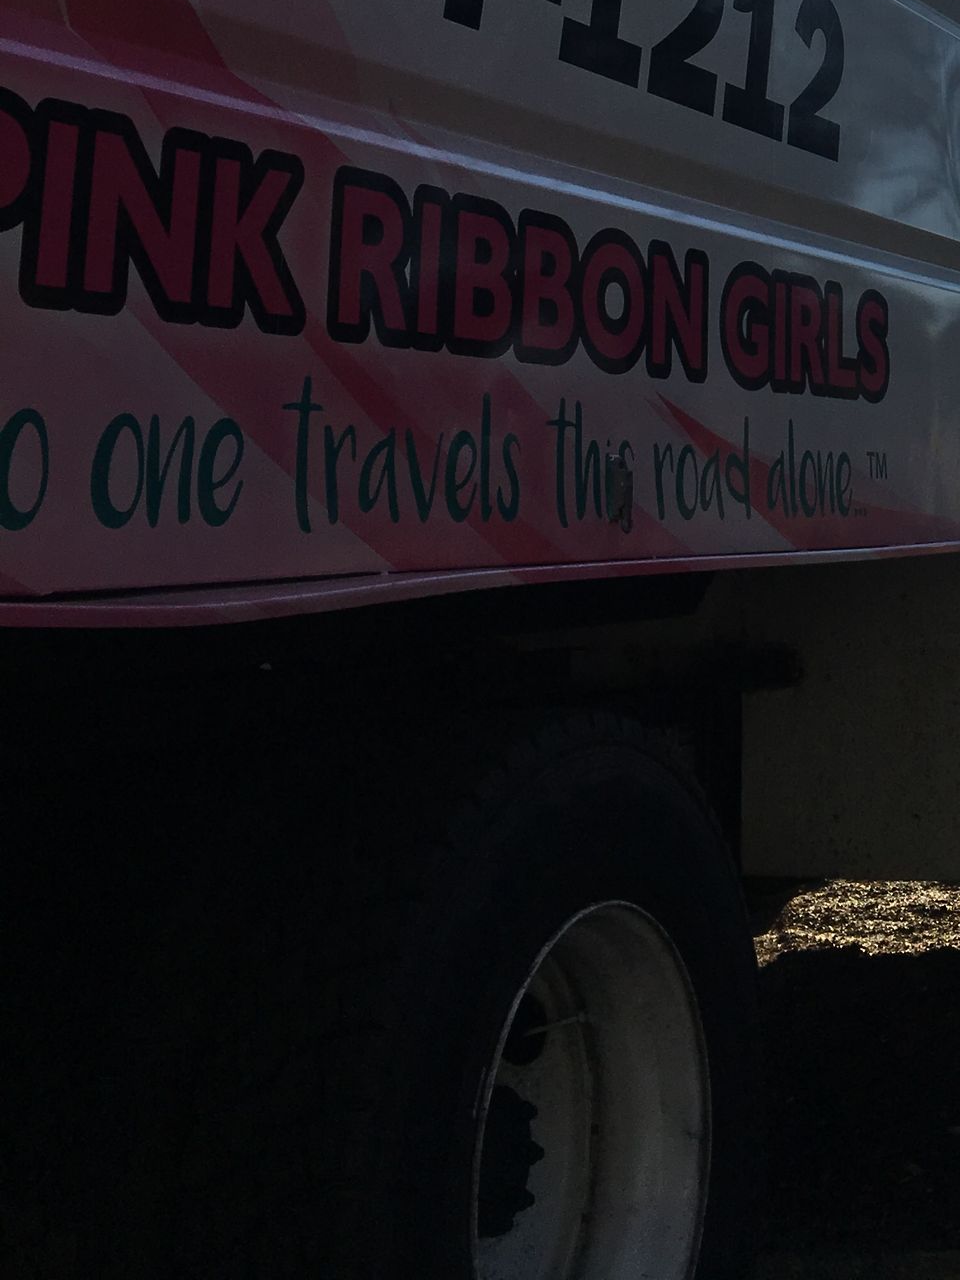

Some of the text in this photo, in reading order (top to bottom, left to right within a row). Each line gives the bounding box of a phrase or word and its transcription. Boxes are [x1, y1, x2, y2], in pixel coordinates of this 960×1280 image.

[326, 165, 709, 384] RIBBON
[720, 260, 890, 404] GIRLS
[90, 413, 244, 529] one
[282, 375, 521, 533] travels
[653, 416, 751, 521] road
